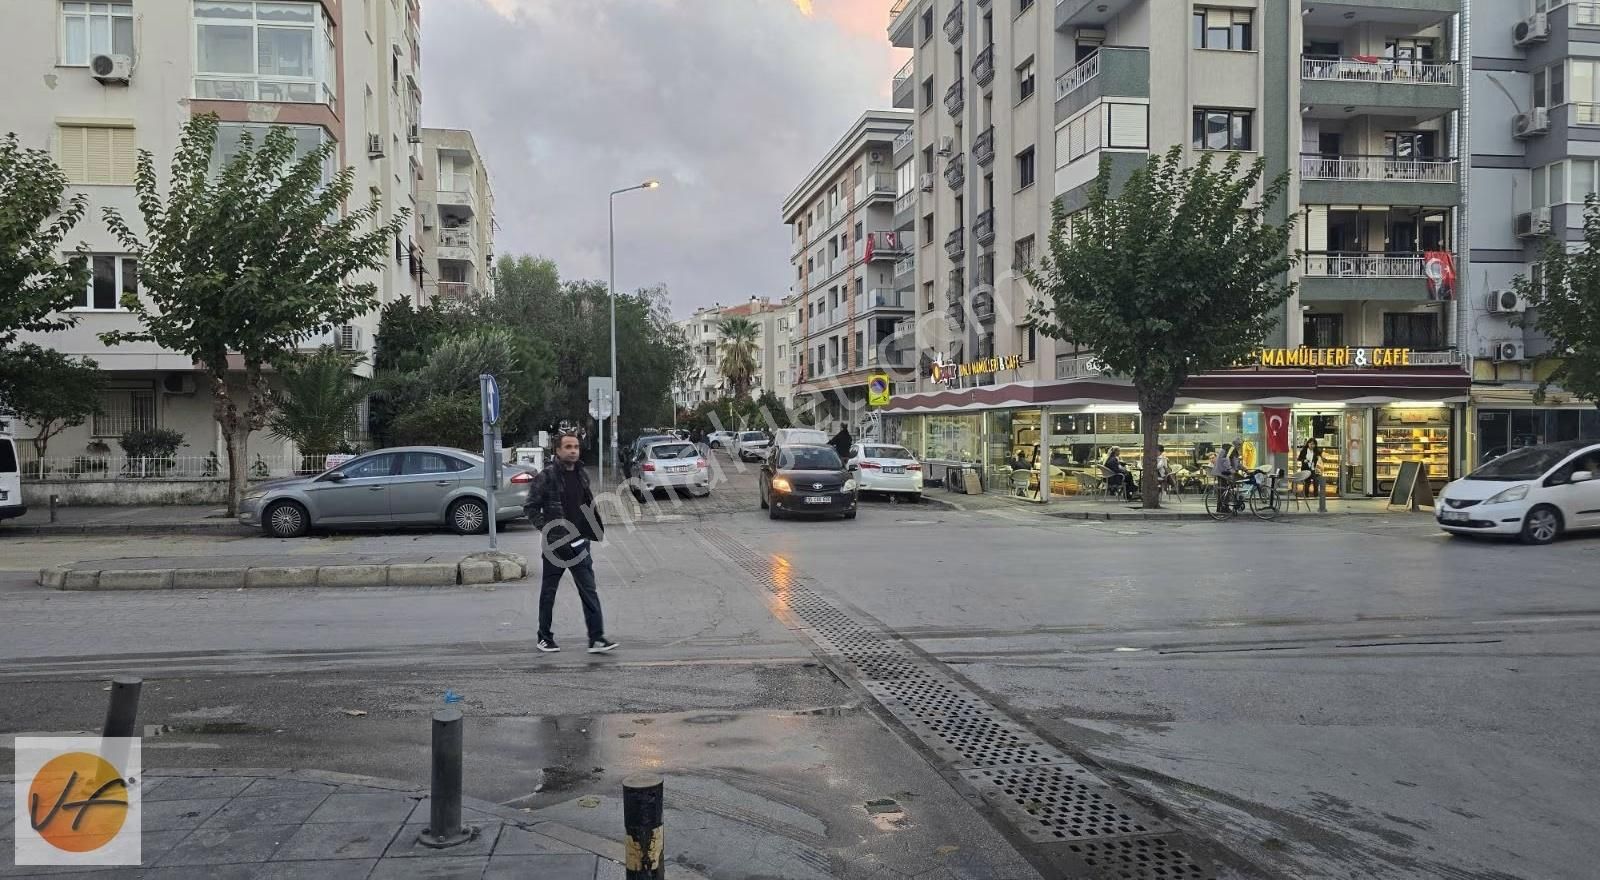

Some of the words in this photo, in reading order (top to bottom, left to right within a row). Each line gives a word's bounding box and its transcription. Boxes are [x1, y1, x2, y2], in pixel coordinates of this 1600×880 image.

[999, 357, 1005, 371] &
[1262, 345, 1349, 366] MAMÜLLERİ
[1355, 348, 1367, 366] &
[1373, 348, 1410, 366] CAFE
